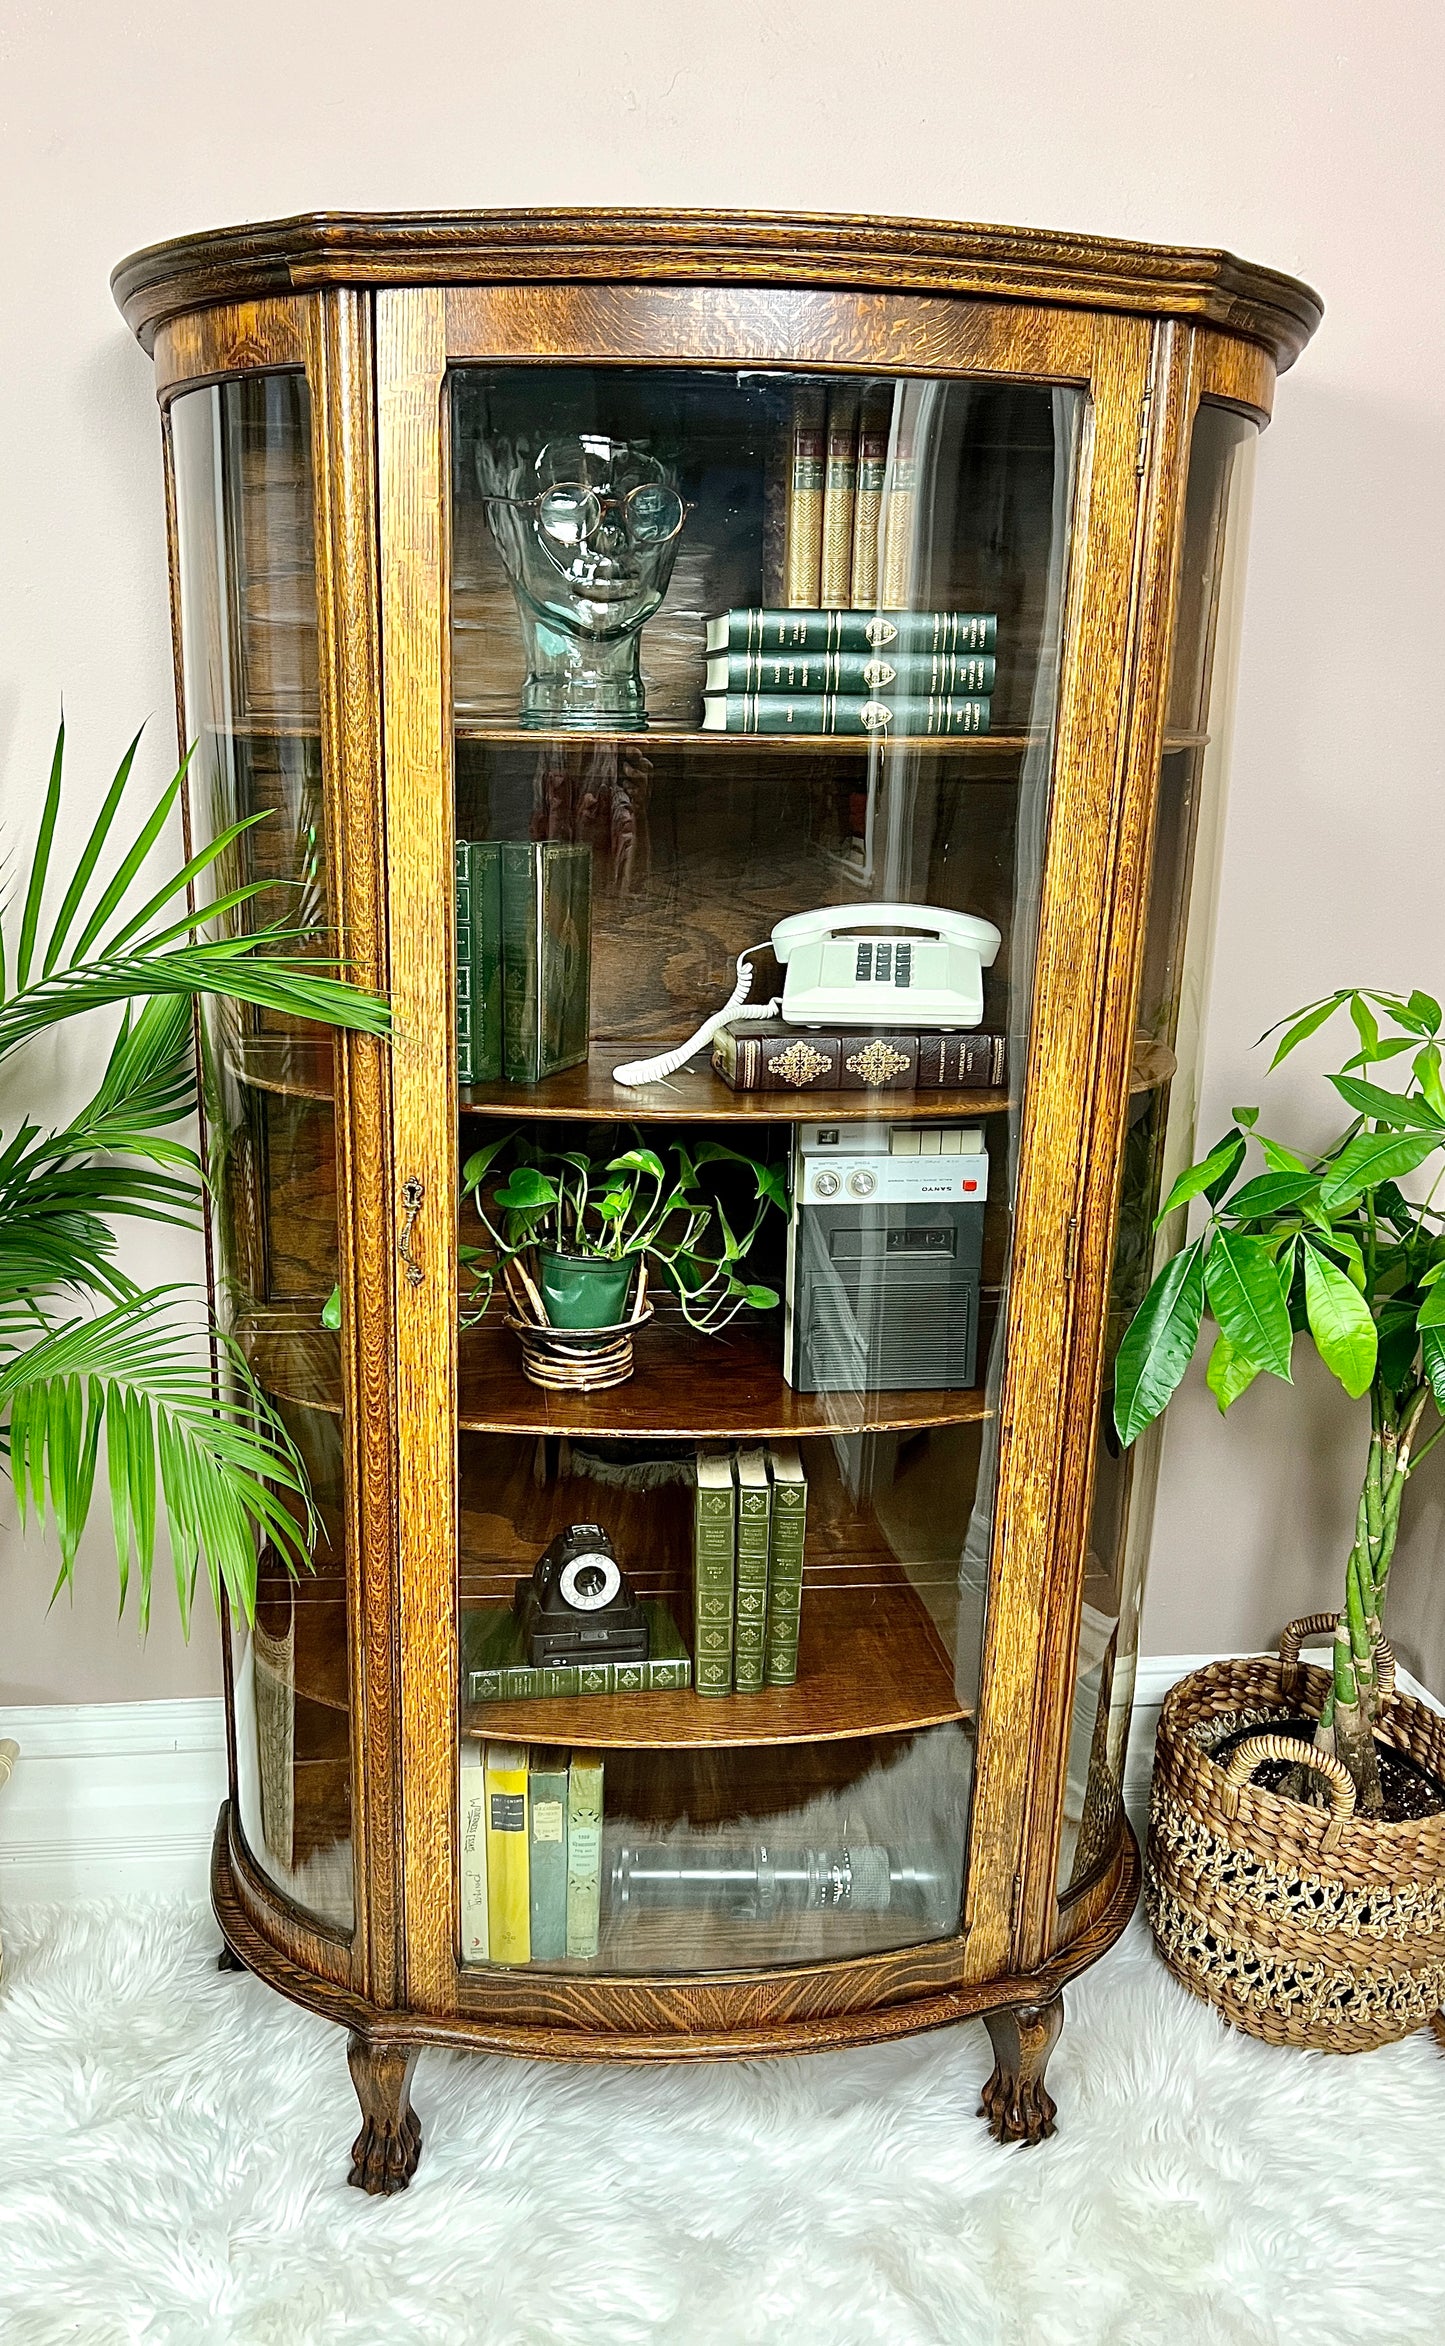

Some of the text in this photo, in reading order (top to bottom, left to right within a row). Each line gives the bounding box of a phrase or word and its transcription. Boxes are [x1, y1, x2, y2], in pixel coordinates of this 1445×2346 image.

[970, 618, 978, 648] HARVARD
[968, 660, 976, 690] HARVARD
[964, 702, 972, 732] HARVARD
[966, 1052, 974, 1072] DAVID
